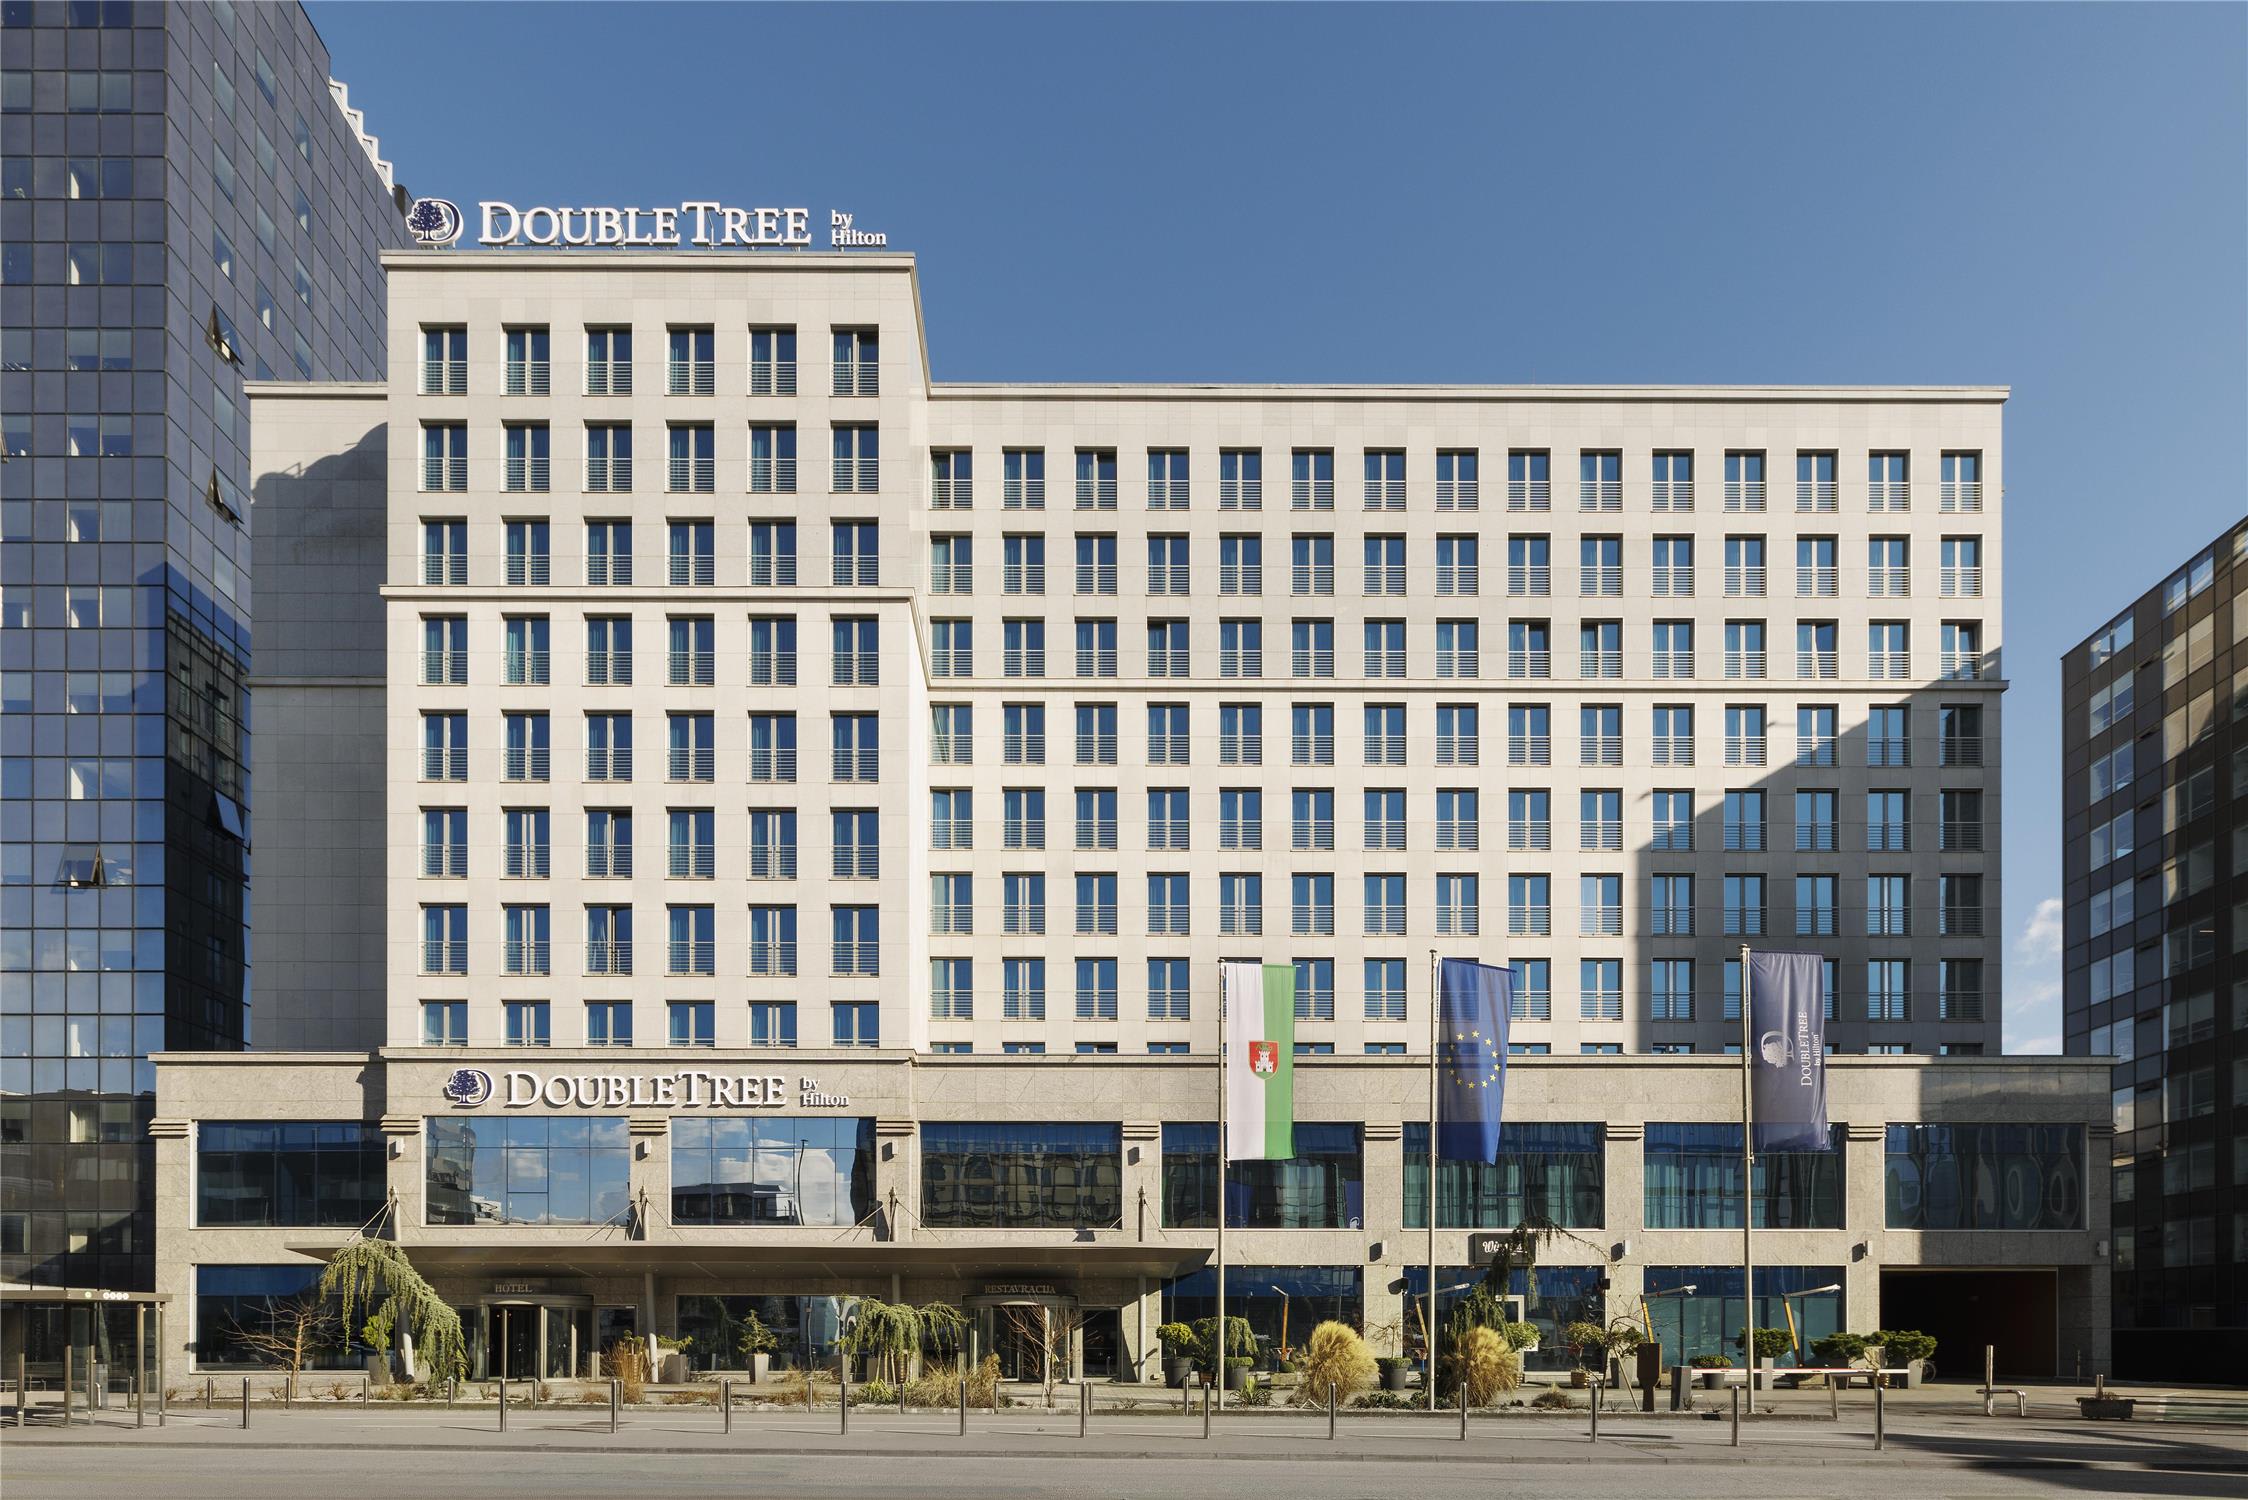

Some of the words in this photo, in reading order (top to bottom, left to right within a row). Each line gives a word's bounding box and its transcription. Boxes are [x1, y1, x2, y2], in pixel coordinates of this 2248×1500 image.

[478, 201, 812, 245] DOUBLETREE
[831, 209, 853, 229] by
[831, 229, 887, 246] Hilton
[1798, 1011, 1812, 1087] DOUBLETREE
[1812, 1034, 1820, 1056] Hilton
[507, 1071, 788, 1105] DOUBLETREE
[802, 1076, 820, 1092] by
[802, 1092, 849, 1107] Hilton
[495, 1283, 533, 1293] HOTEL
[984, 1284, 1057, 1294] RESTAVRACIJA
